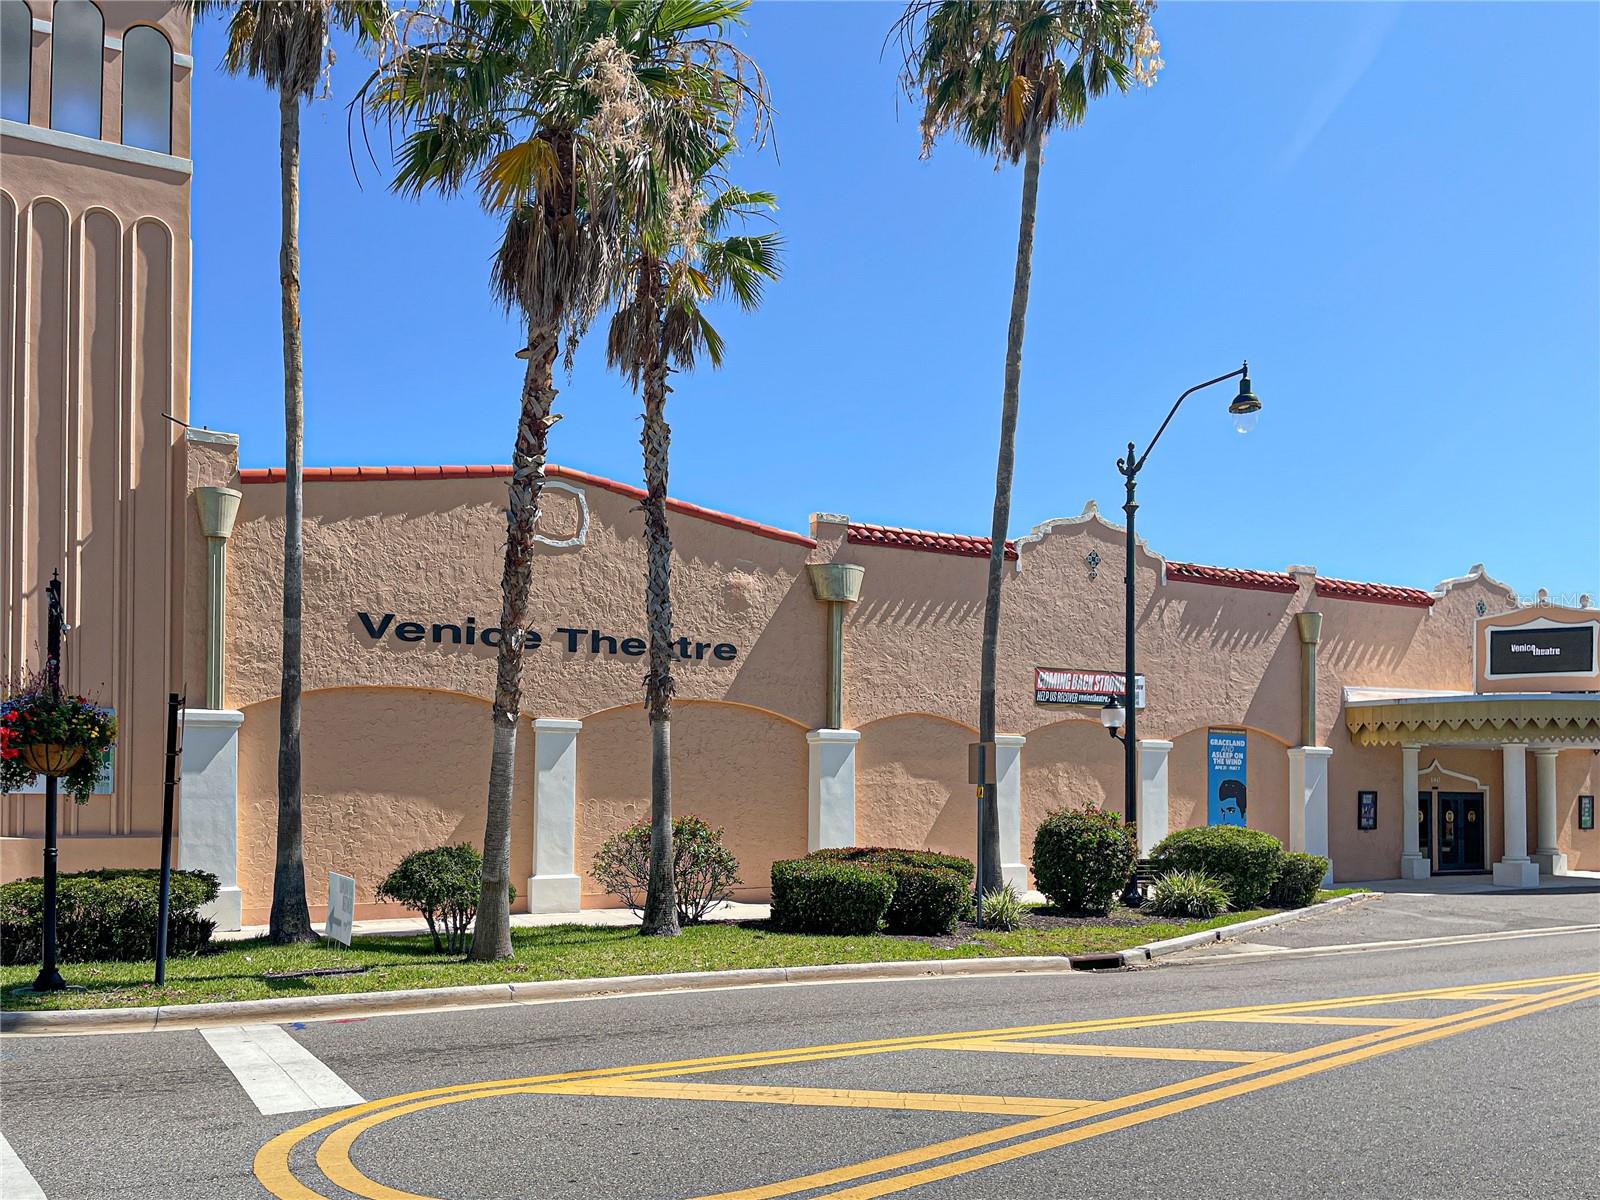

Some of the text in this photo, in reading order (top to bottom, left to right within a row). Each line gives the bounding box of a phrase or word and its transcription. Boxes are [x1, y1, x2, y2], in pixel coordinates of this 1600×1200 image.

[556, 627, 738, 662] Thetre
[1511, 643, 1561, 656] Venice theatre
[1037, 671, 1071, 690] COMING
[1071, 673, 1094, 691] BACK
[1036, 690, 1049, 702] HELP
[1049, 691, 1057, 702] US
[1057, 692, 1078, 703] RECOVER
[1210, 738, 1245, 747] GRACELAND
[1211, 751, 1233, 759] ASLEEP
[1213, 757, 1242, 766] THE WIND
